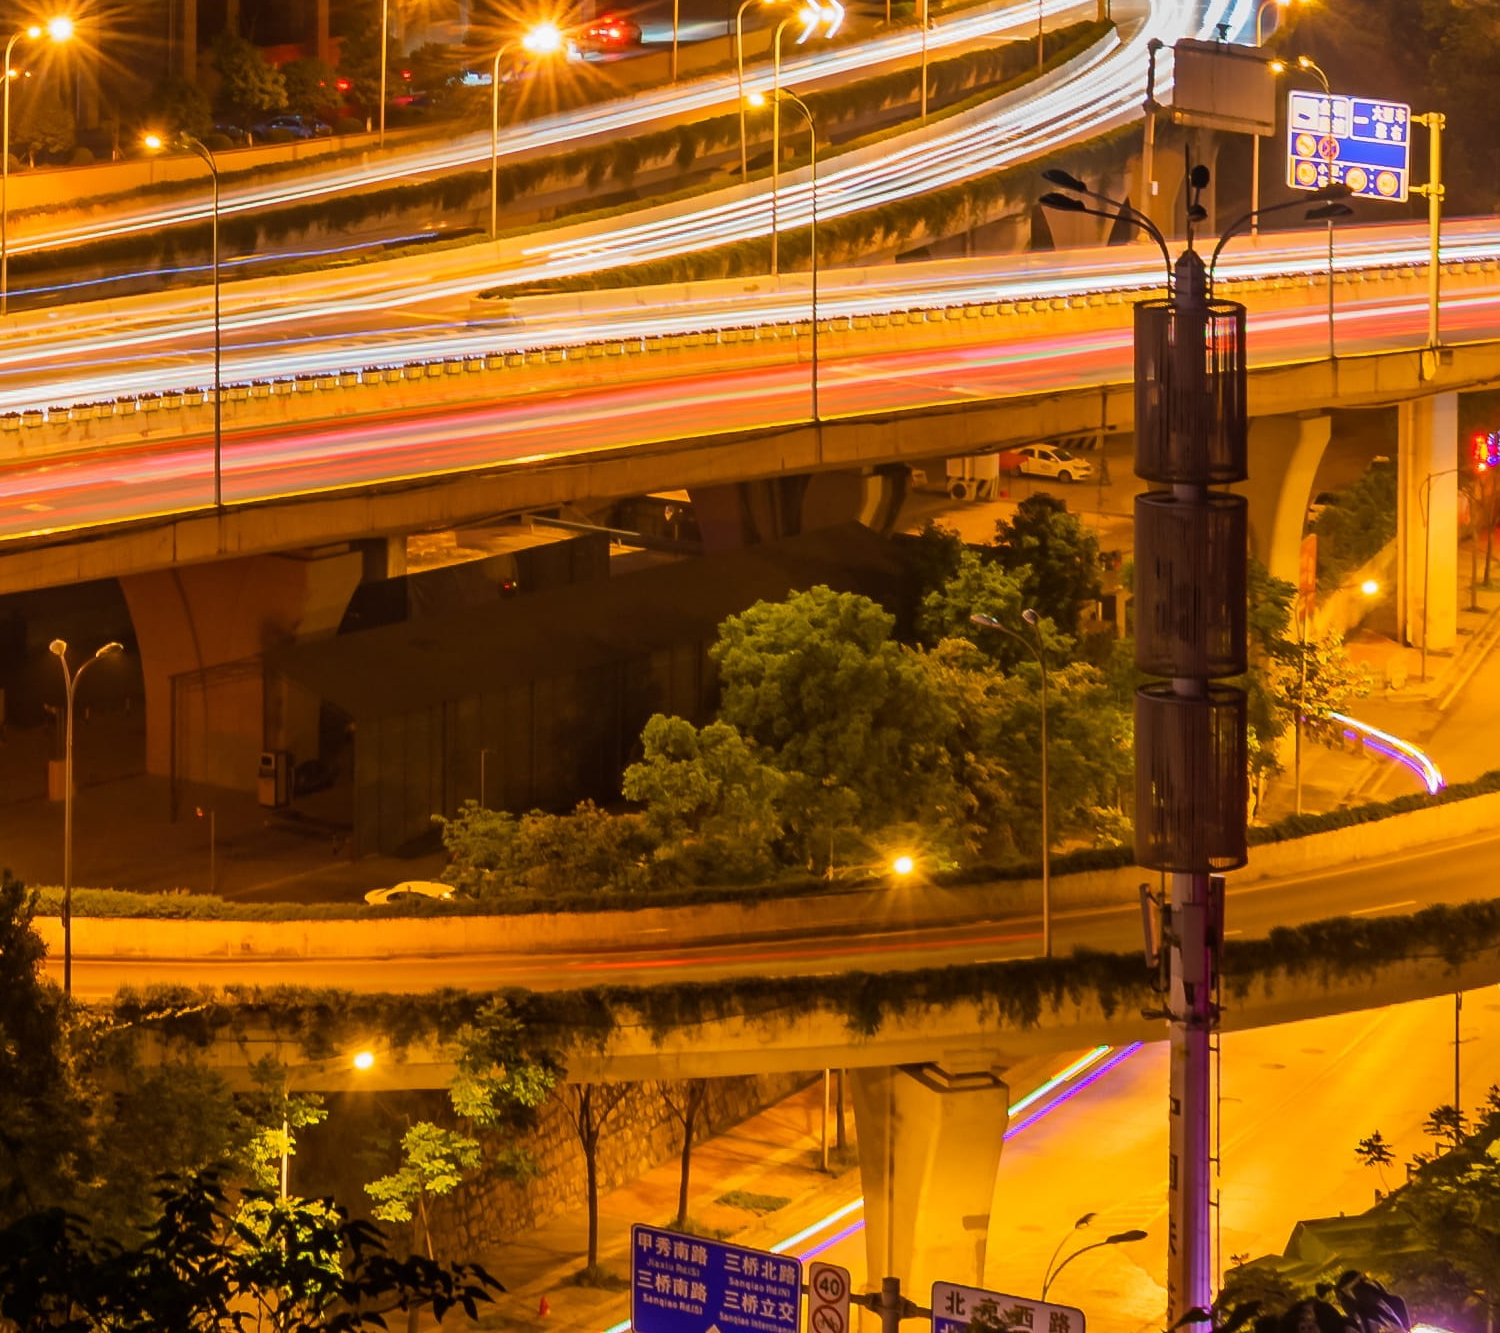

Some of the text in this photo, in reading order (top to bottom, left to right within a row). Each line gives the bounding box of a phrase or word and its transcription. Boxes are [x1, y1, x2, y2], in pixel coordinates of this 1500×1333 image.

[638, 1232, 708, 1266] 甲秀南路
[637, 1269, 708, 1303] 三桥南路
[724, 1253, 796, 1286] 三桥北路
[728, 1276, 765, 1293] Sanqiao
[643, 1293, 678, 1309] Sanqiao
[819, 1277, 840, 1296] 40
[723, 1290, 795, 1323] 三桥立交
[945, 1290, 1071, 1333] 北京西路
